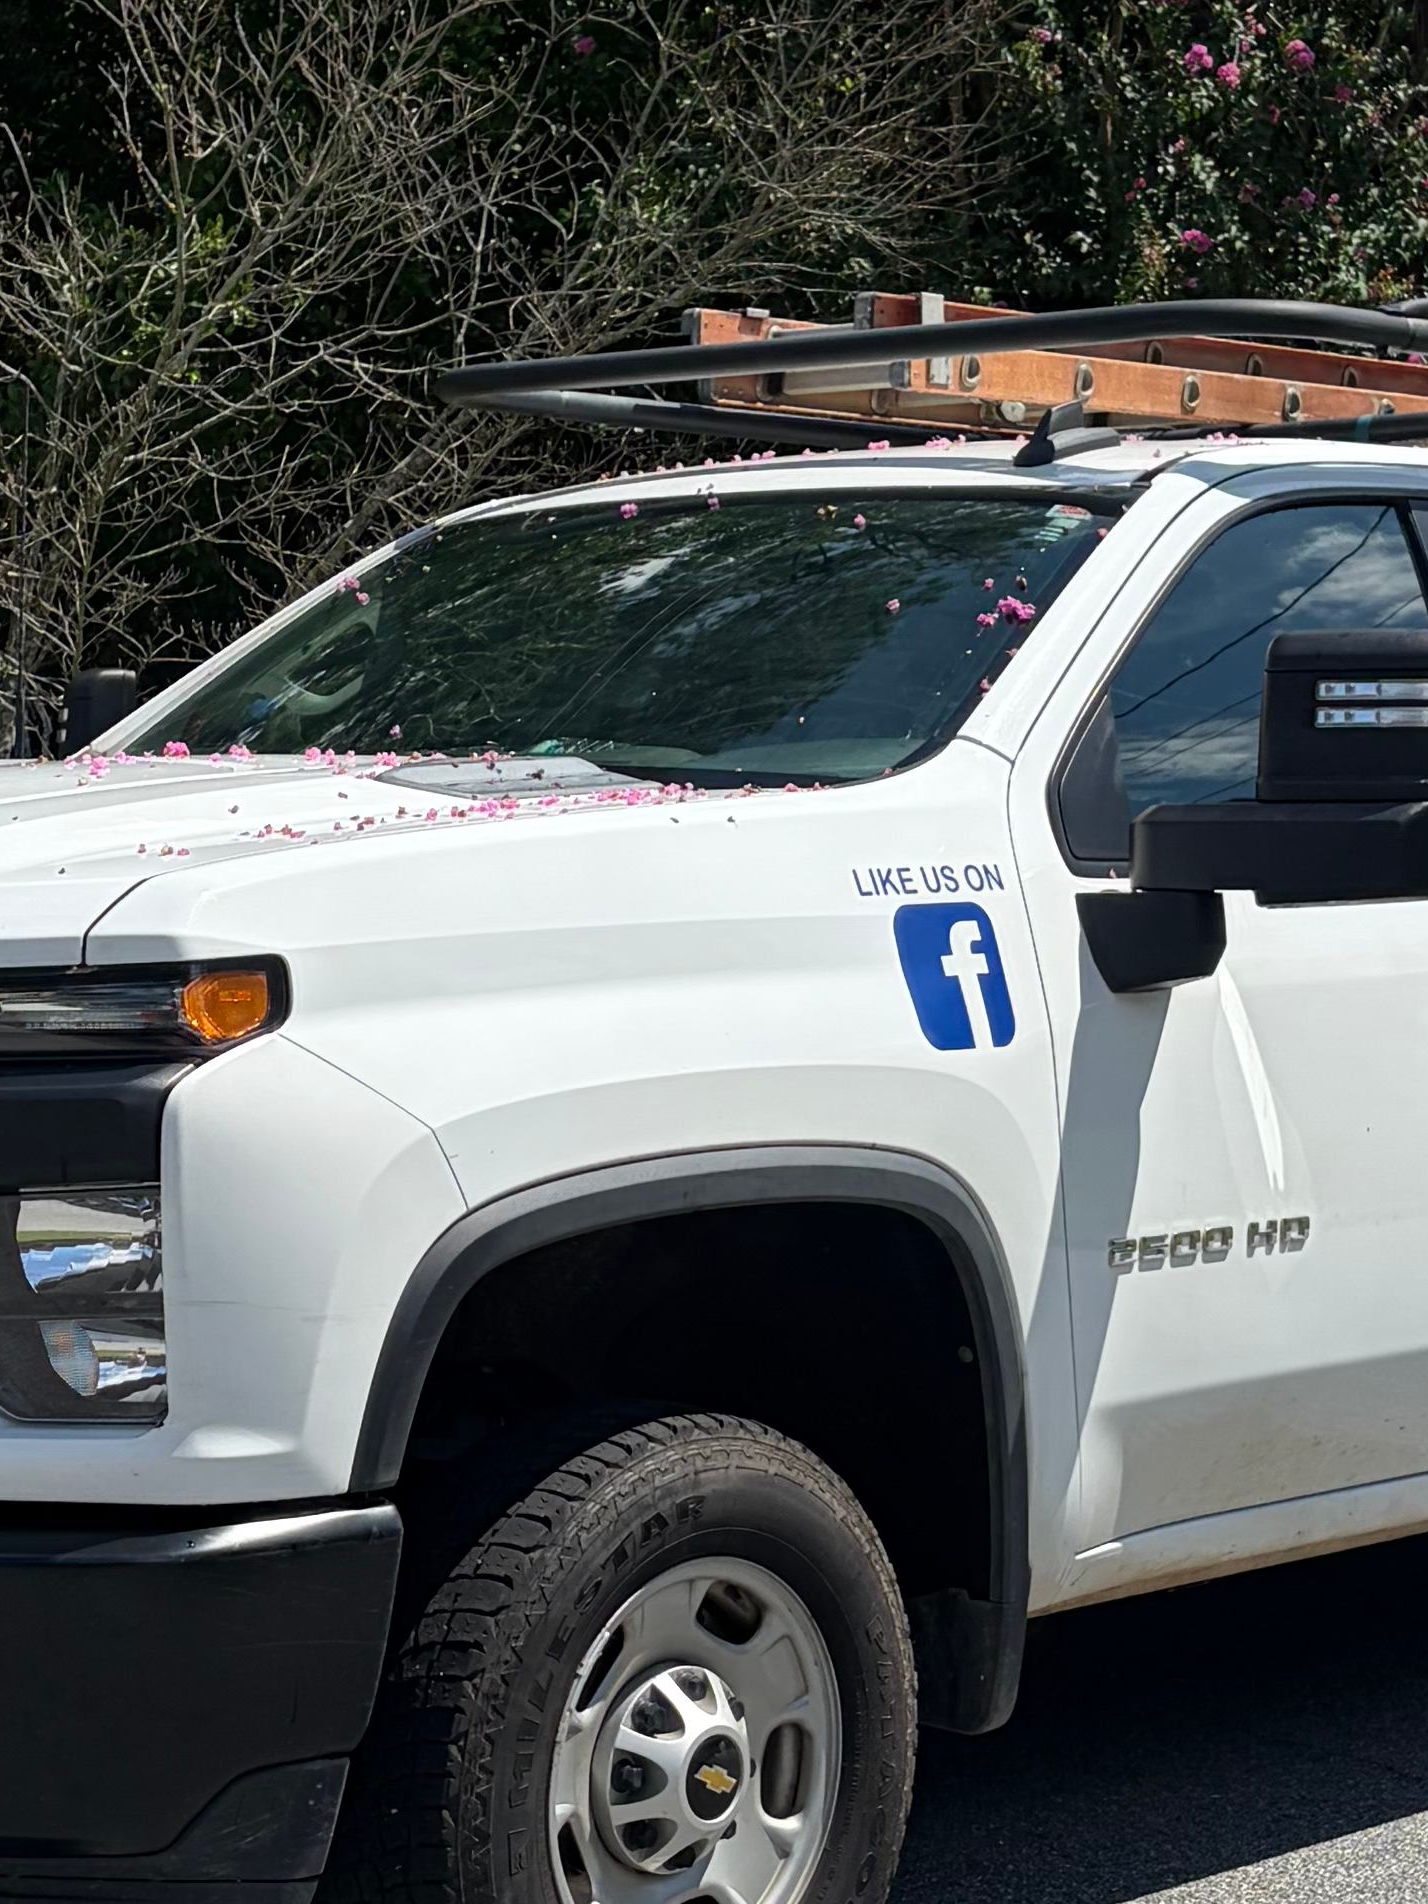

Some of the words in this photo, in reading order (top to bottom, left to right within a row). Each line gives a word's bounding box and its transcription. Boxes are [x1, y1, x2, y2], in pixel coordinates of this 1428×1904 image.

[852, 868, 918, 896] LIKE
[920, 865, 959, 893] US
[964, 864, 1004, 891] ON
[1108, 1226, 1233, 1269] 2500
[1247, 1216, 1310, 1254] HD
